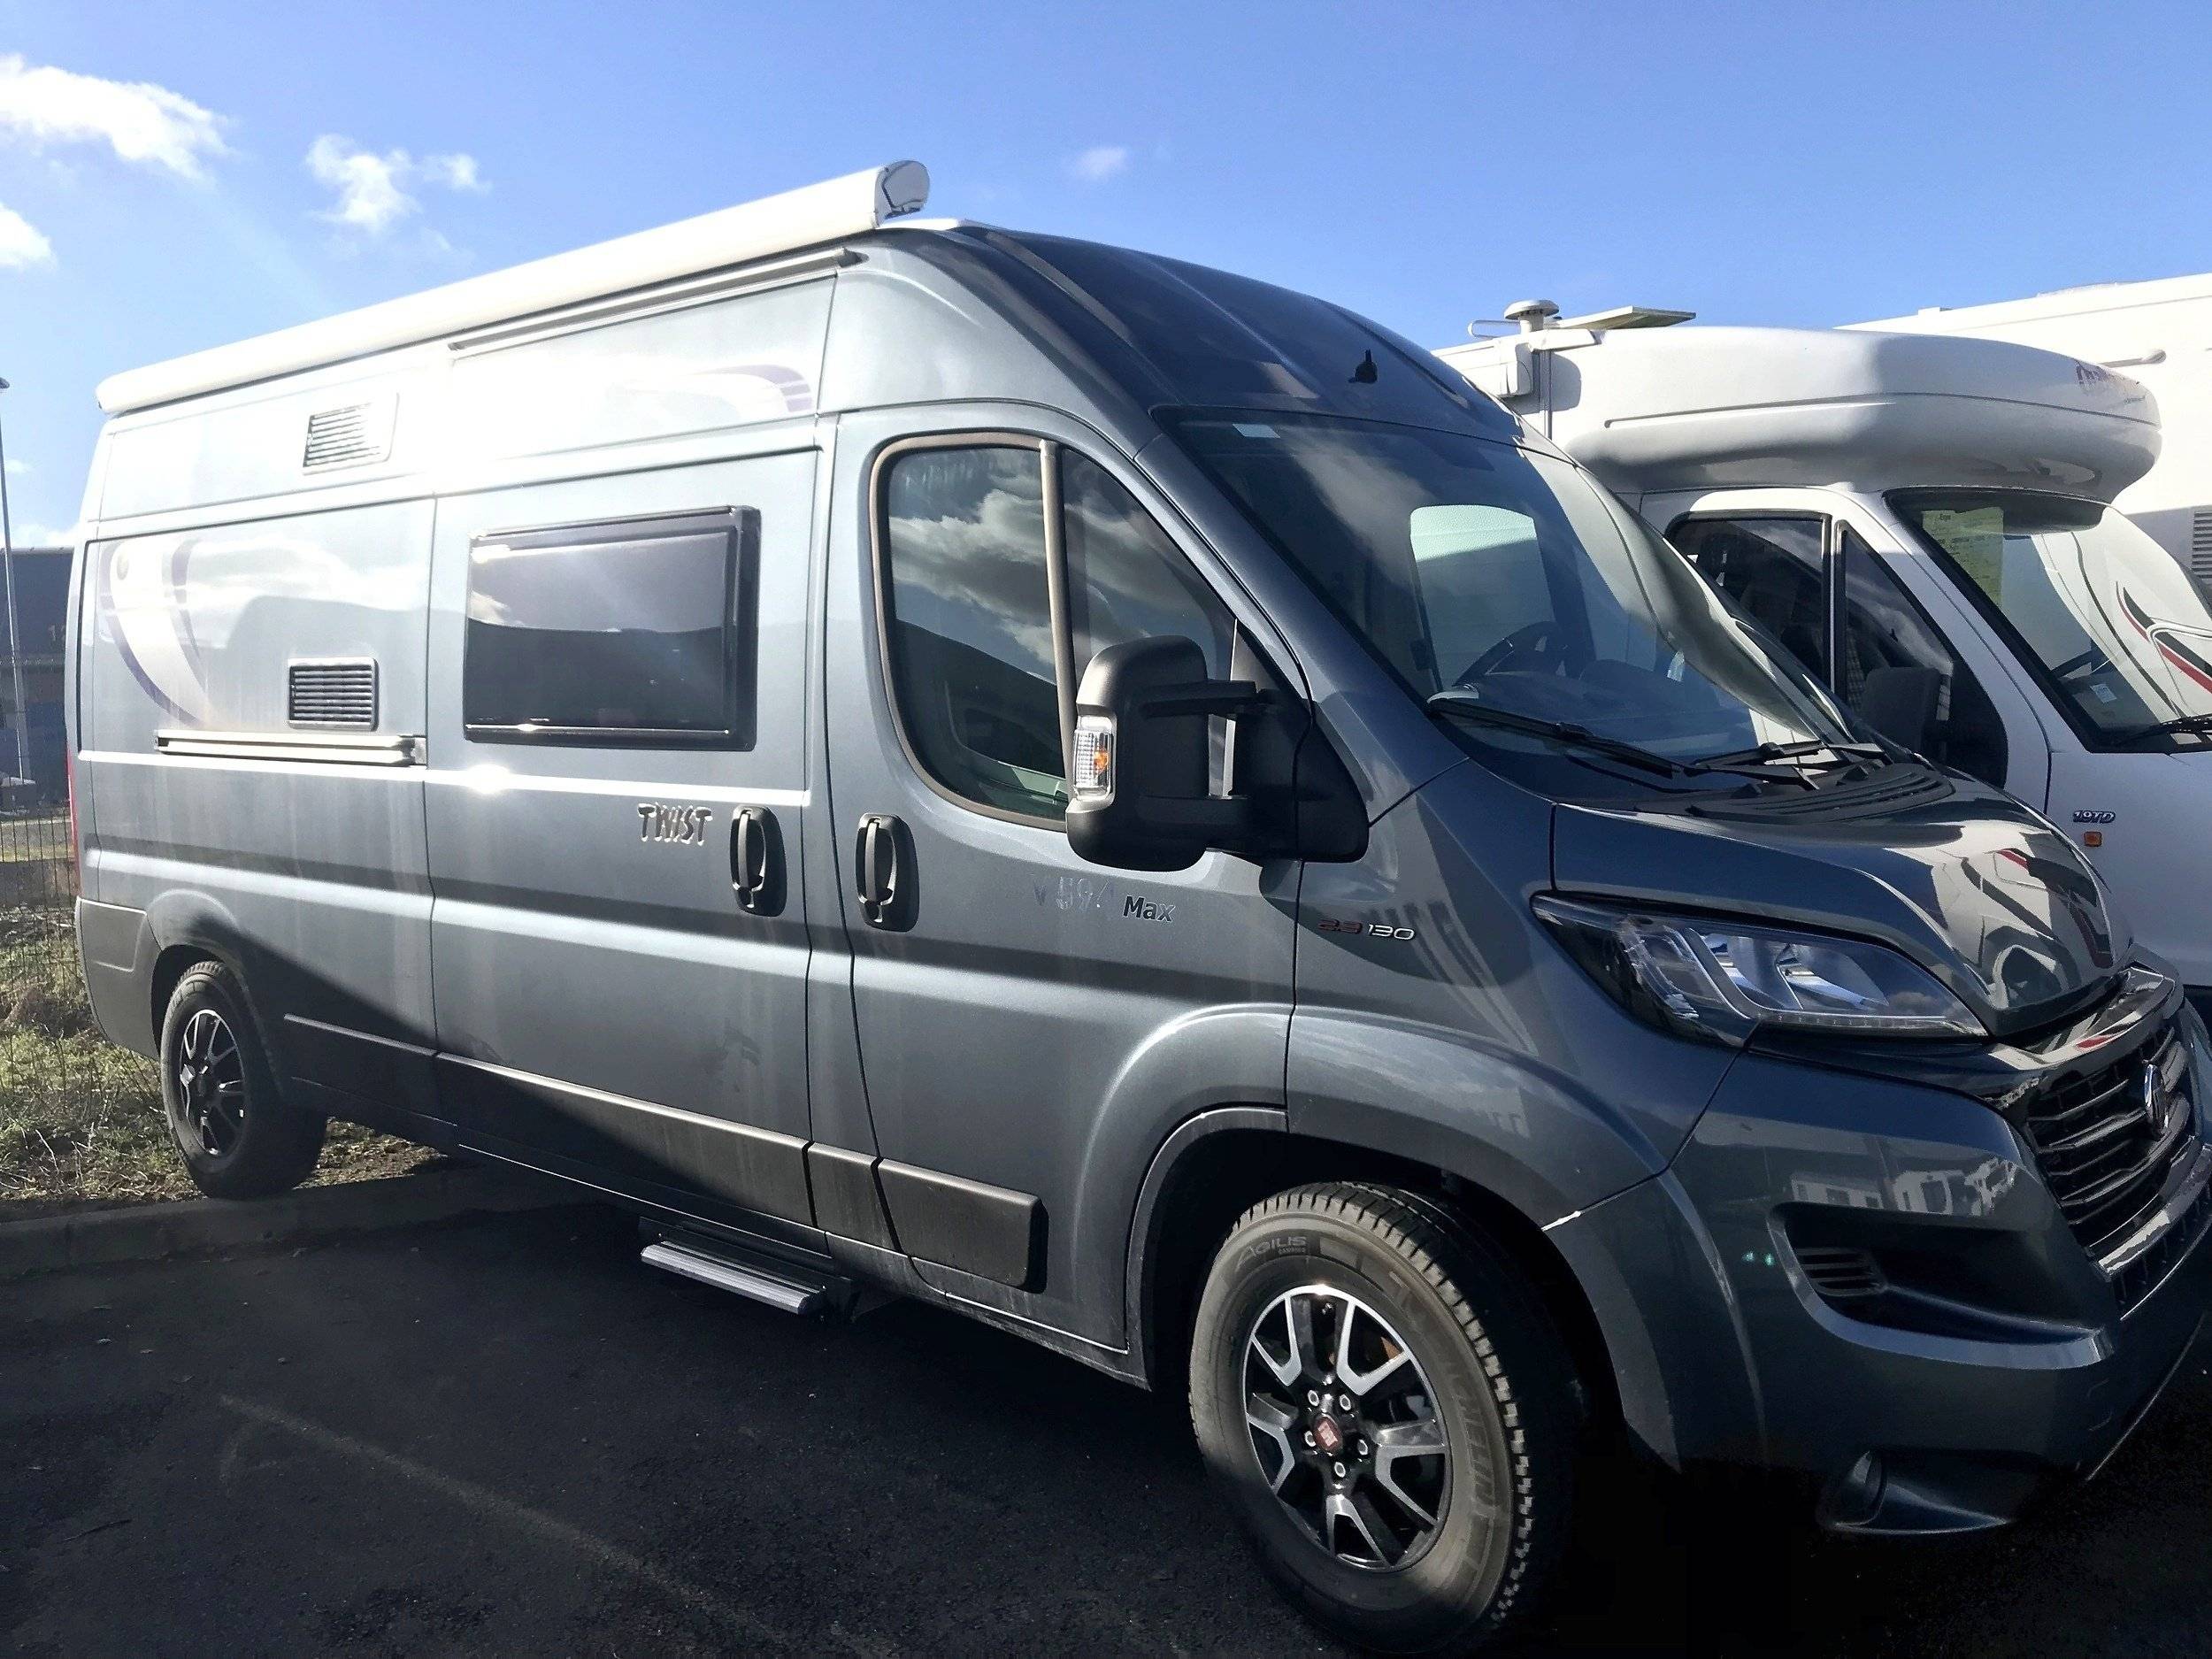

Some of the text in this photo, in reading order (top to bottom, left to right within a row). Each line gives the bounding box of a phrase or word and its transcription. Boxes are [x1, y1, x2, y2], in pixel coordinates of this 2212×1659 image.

[637, 802, 714, 847] TWIST
[1123, 895, 1176, 922] Max
[1368, 923, 1416, 941] 130
